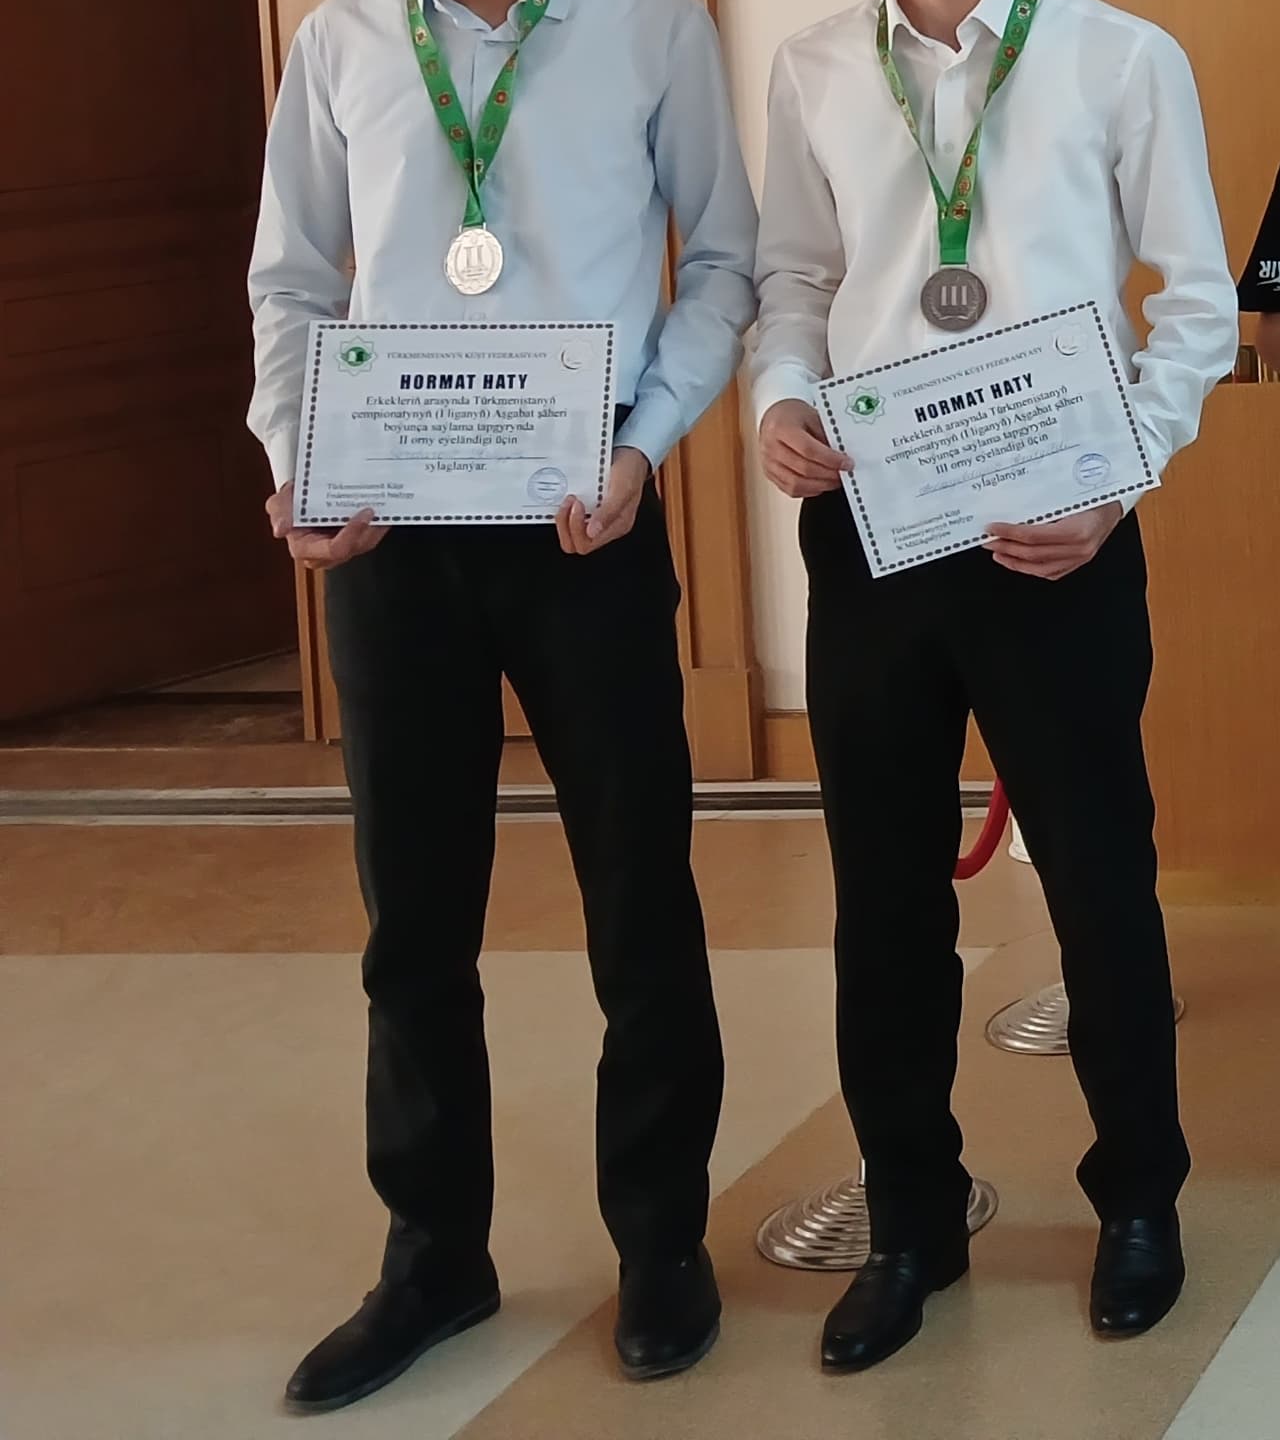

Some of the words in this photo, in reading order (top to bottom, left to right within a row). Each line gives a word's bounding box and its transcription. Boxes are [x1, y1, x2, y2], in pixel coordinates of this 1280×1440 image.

[399, 374, 477, 390] HORMAT
[482, 373, 528, 390] HATY
[914, 387, 985, 423] HORMAT
[989, 372, 1033, 400] HATY
